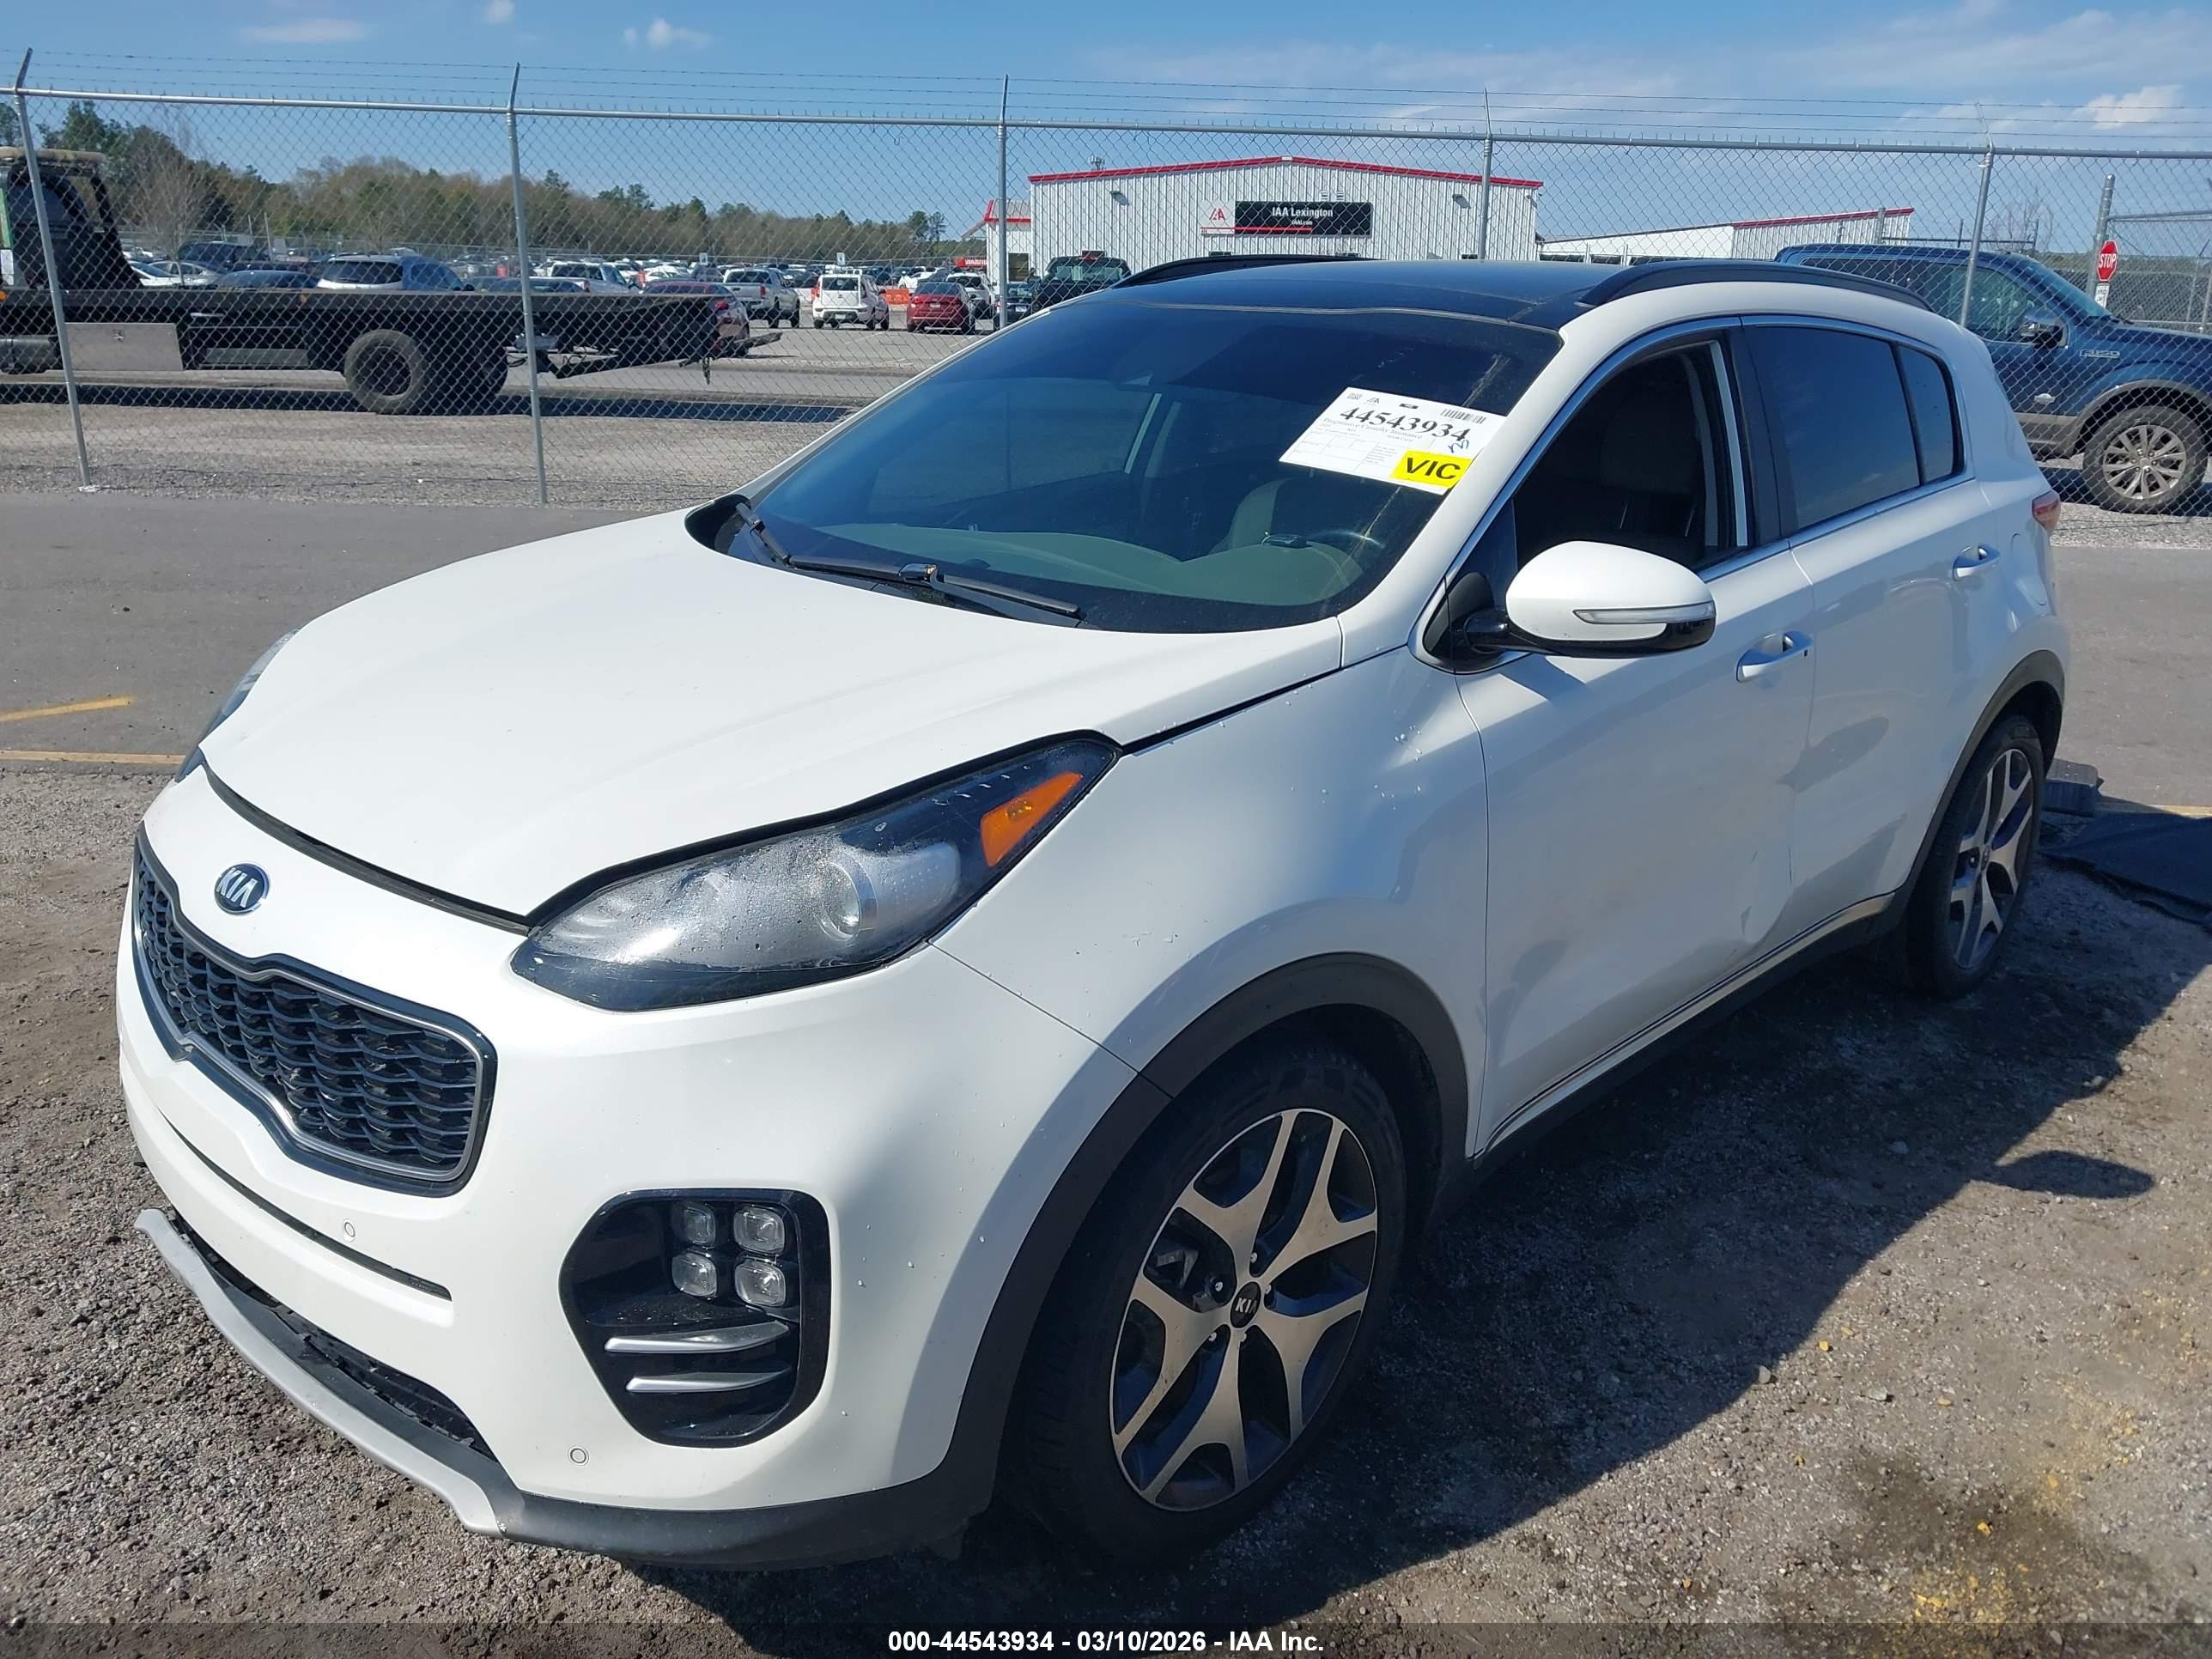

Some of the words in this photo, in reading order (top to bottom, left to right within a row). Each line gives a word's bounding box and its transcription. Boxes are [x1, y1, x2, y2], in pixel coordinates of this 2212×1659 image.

[1272, 206, 1289, 216] IAA
[1291, 206, 1334, 219] Lexington
[2099, 253, 2117, 268] STOP
[1340, 407, 1470, 441] 44543934
[1407, 457, 1461, 480] VIC
[216, 866, 258, 908] KIA
[1235, 1297, 1258, 1314] KIA
